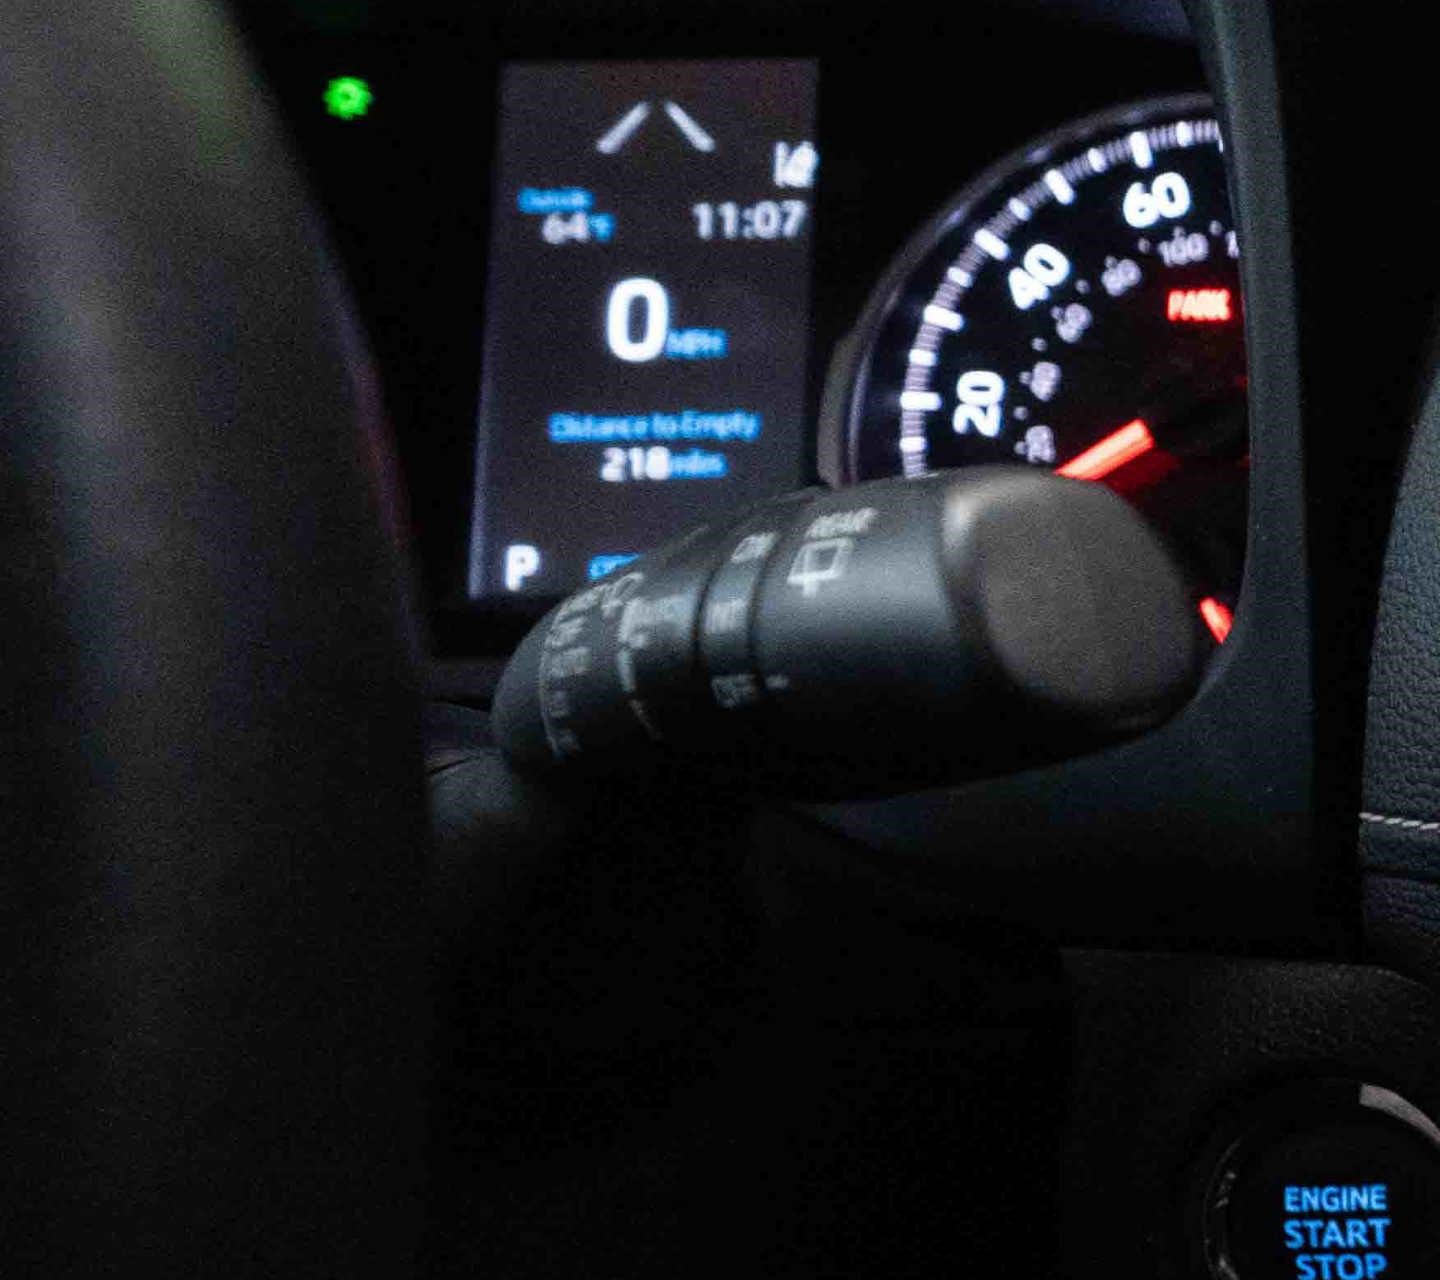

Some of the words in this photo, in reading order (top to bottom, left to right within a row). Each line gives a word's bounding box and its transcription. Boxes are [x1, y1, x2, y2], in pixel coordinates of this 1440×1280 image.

[692, 199, 806, 240] 11:07
[1123, 171, 1190, 227] 60
[1008, 243, 1070, 310] 40
[607, 277, 669, 362] 0
[1168, 288, 1231, 321] PARK
[951, 370, 1005, 438] 20
[503, 544, 541, 590] P
[1284, 1184, 1387, 1213] ENGINE
[1284, 1217, 1391, 1249] START
